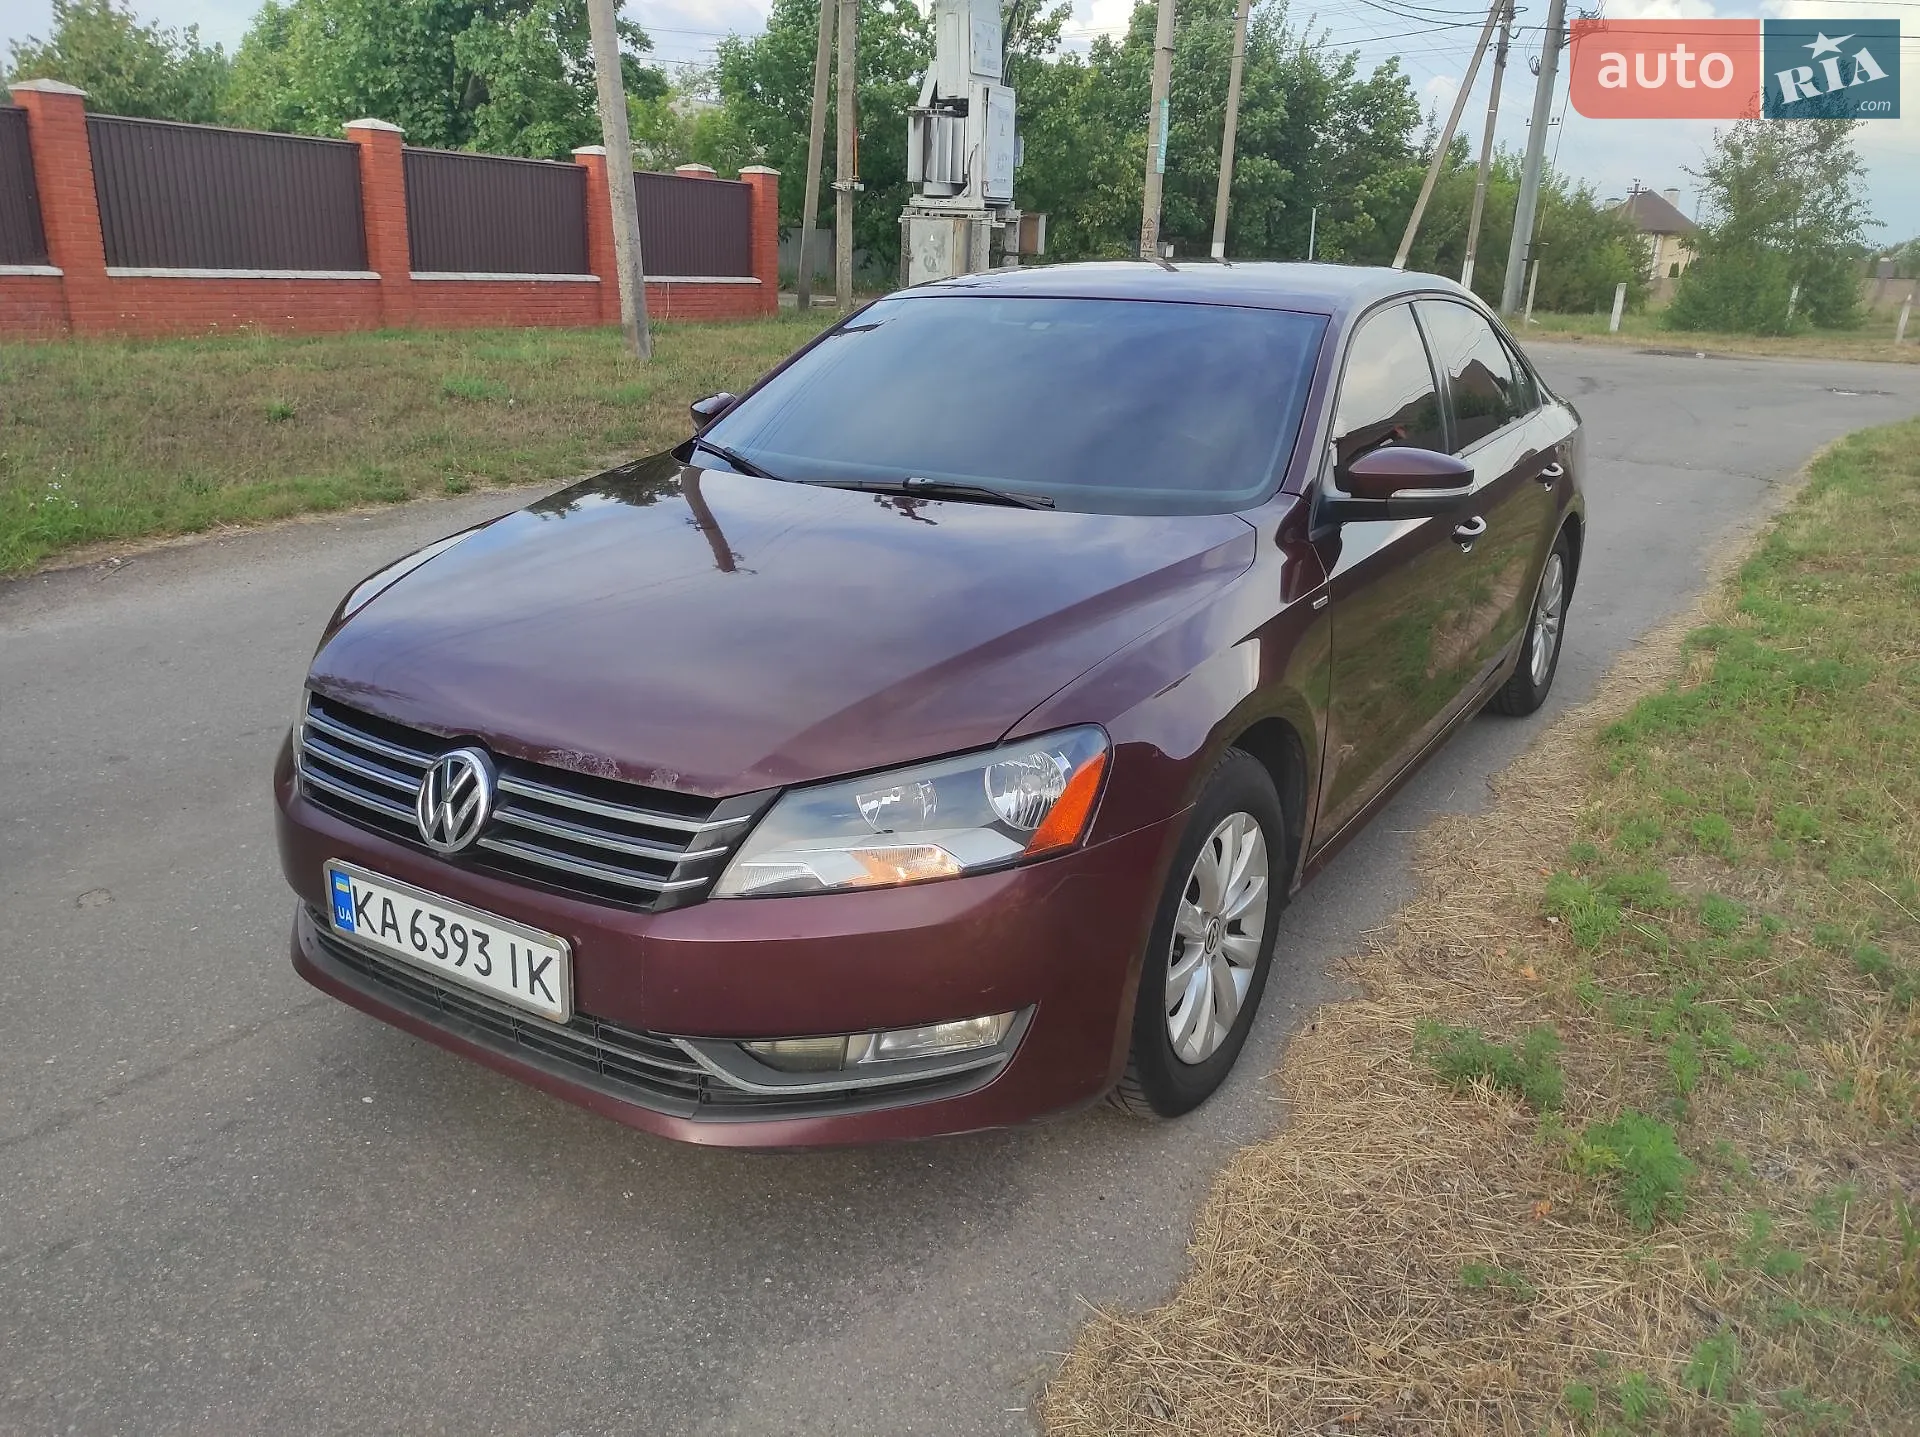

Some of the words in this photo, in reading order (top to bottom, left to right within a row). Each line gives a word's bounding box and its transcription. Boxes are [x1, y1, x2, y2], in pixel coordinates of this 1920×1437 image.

[338, 905, 353, 924] UA
[352, 885, 402, 944] KA
[410, 908, 492, 977] 6393
[510, 942, 556, 1003] IK
